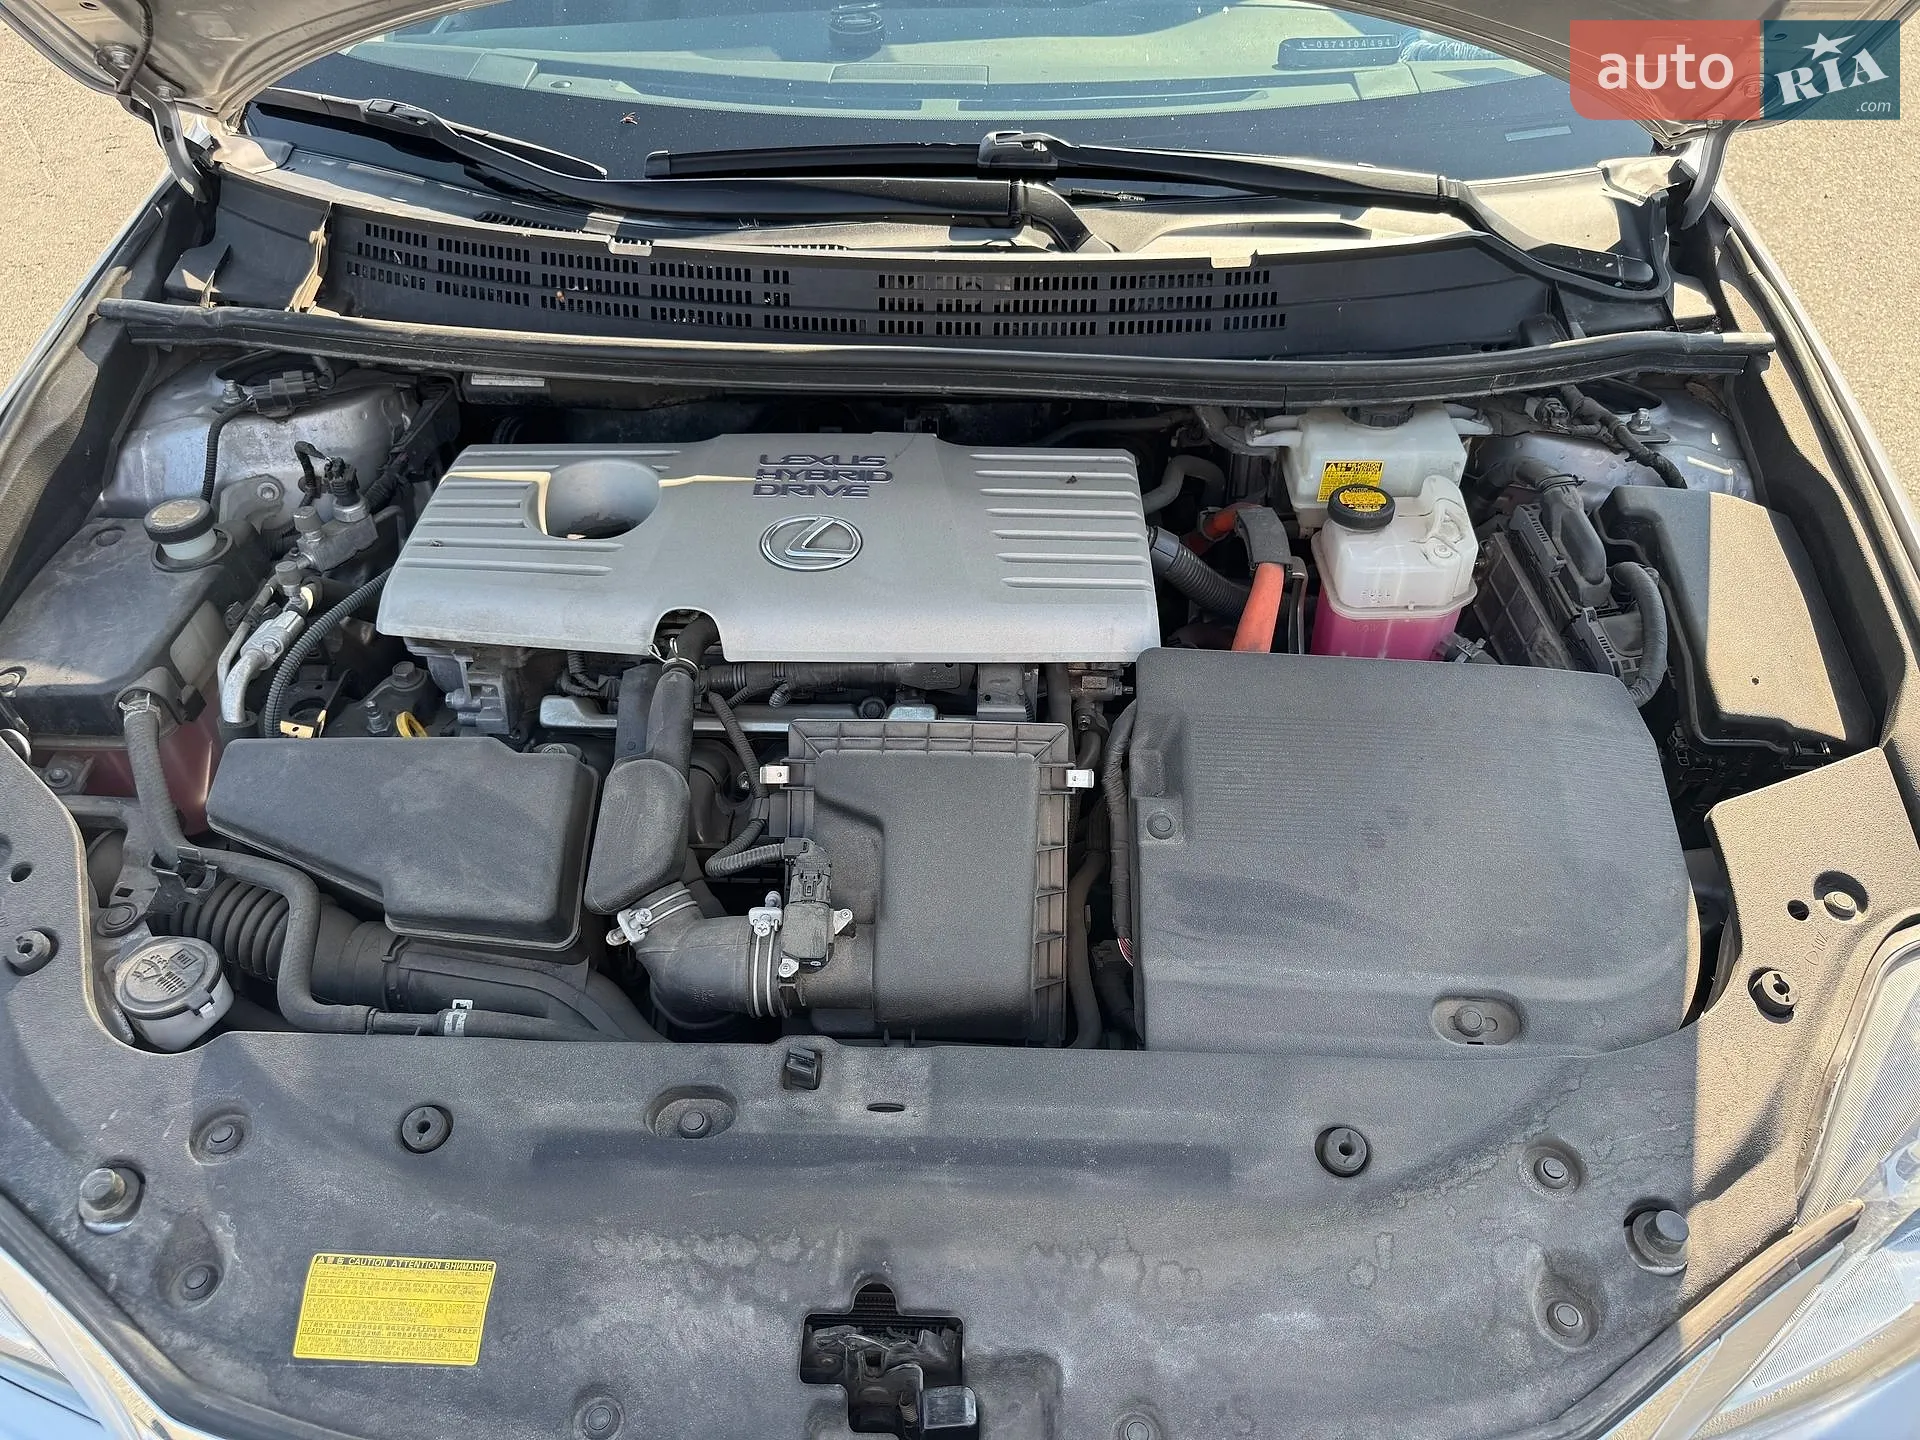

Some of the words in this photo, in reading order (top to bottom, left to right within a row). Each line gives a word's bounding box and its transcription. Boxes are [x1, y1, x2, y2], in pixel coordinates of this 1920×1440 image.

[760, 454, 887, 468] LEXUS
[756, 468, 893, 483] HYBRID
[752, 484, 870, 499] DRIVE
[348, 1256, 388, 1266] CAUTION
[391, 1259, 441, 1269] ATTENTION
[444, 1262, 492, 1271] ВНИМАНИЕ
